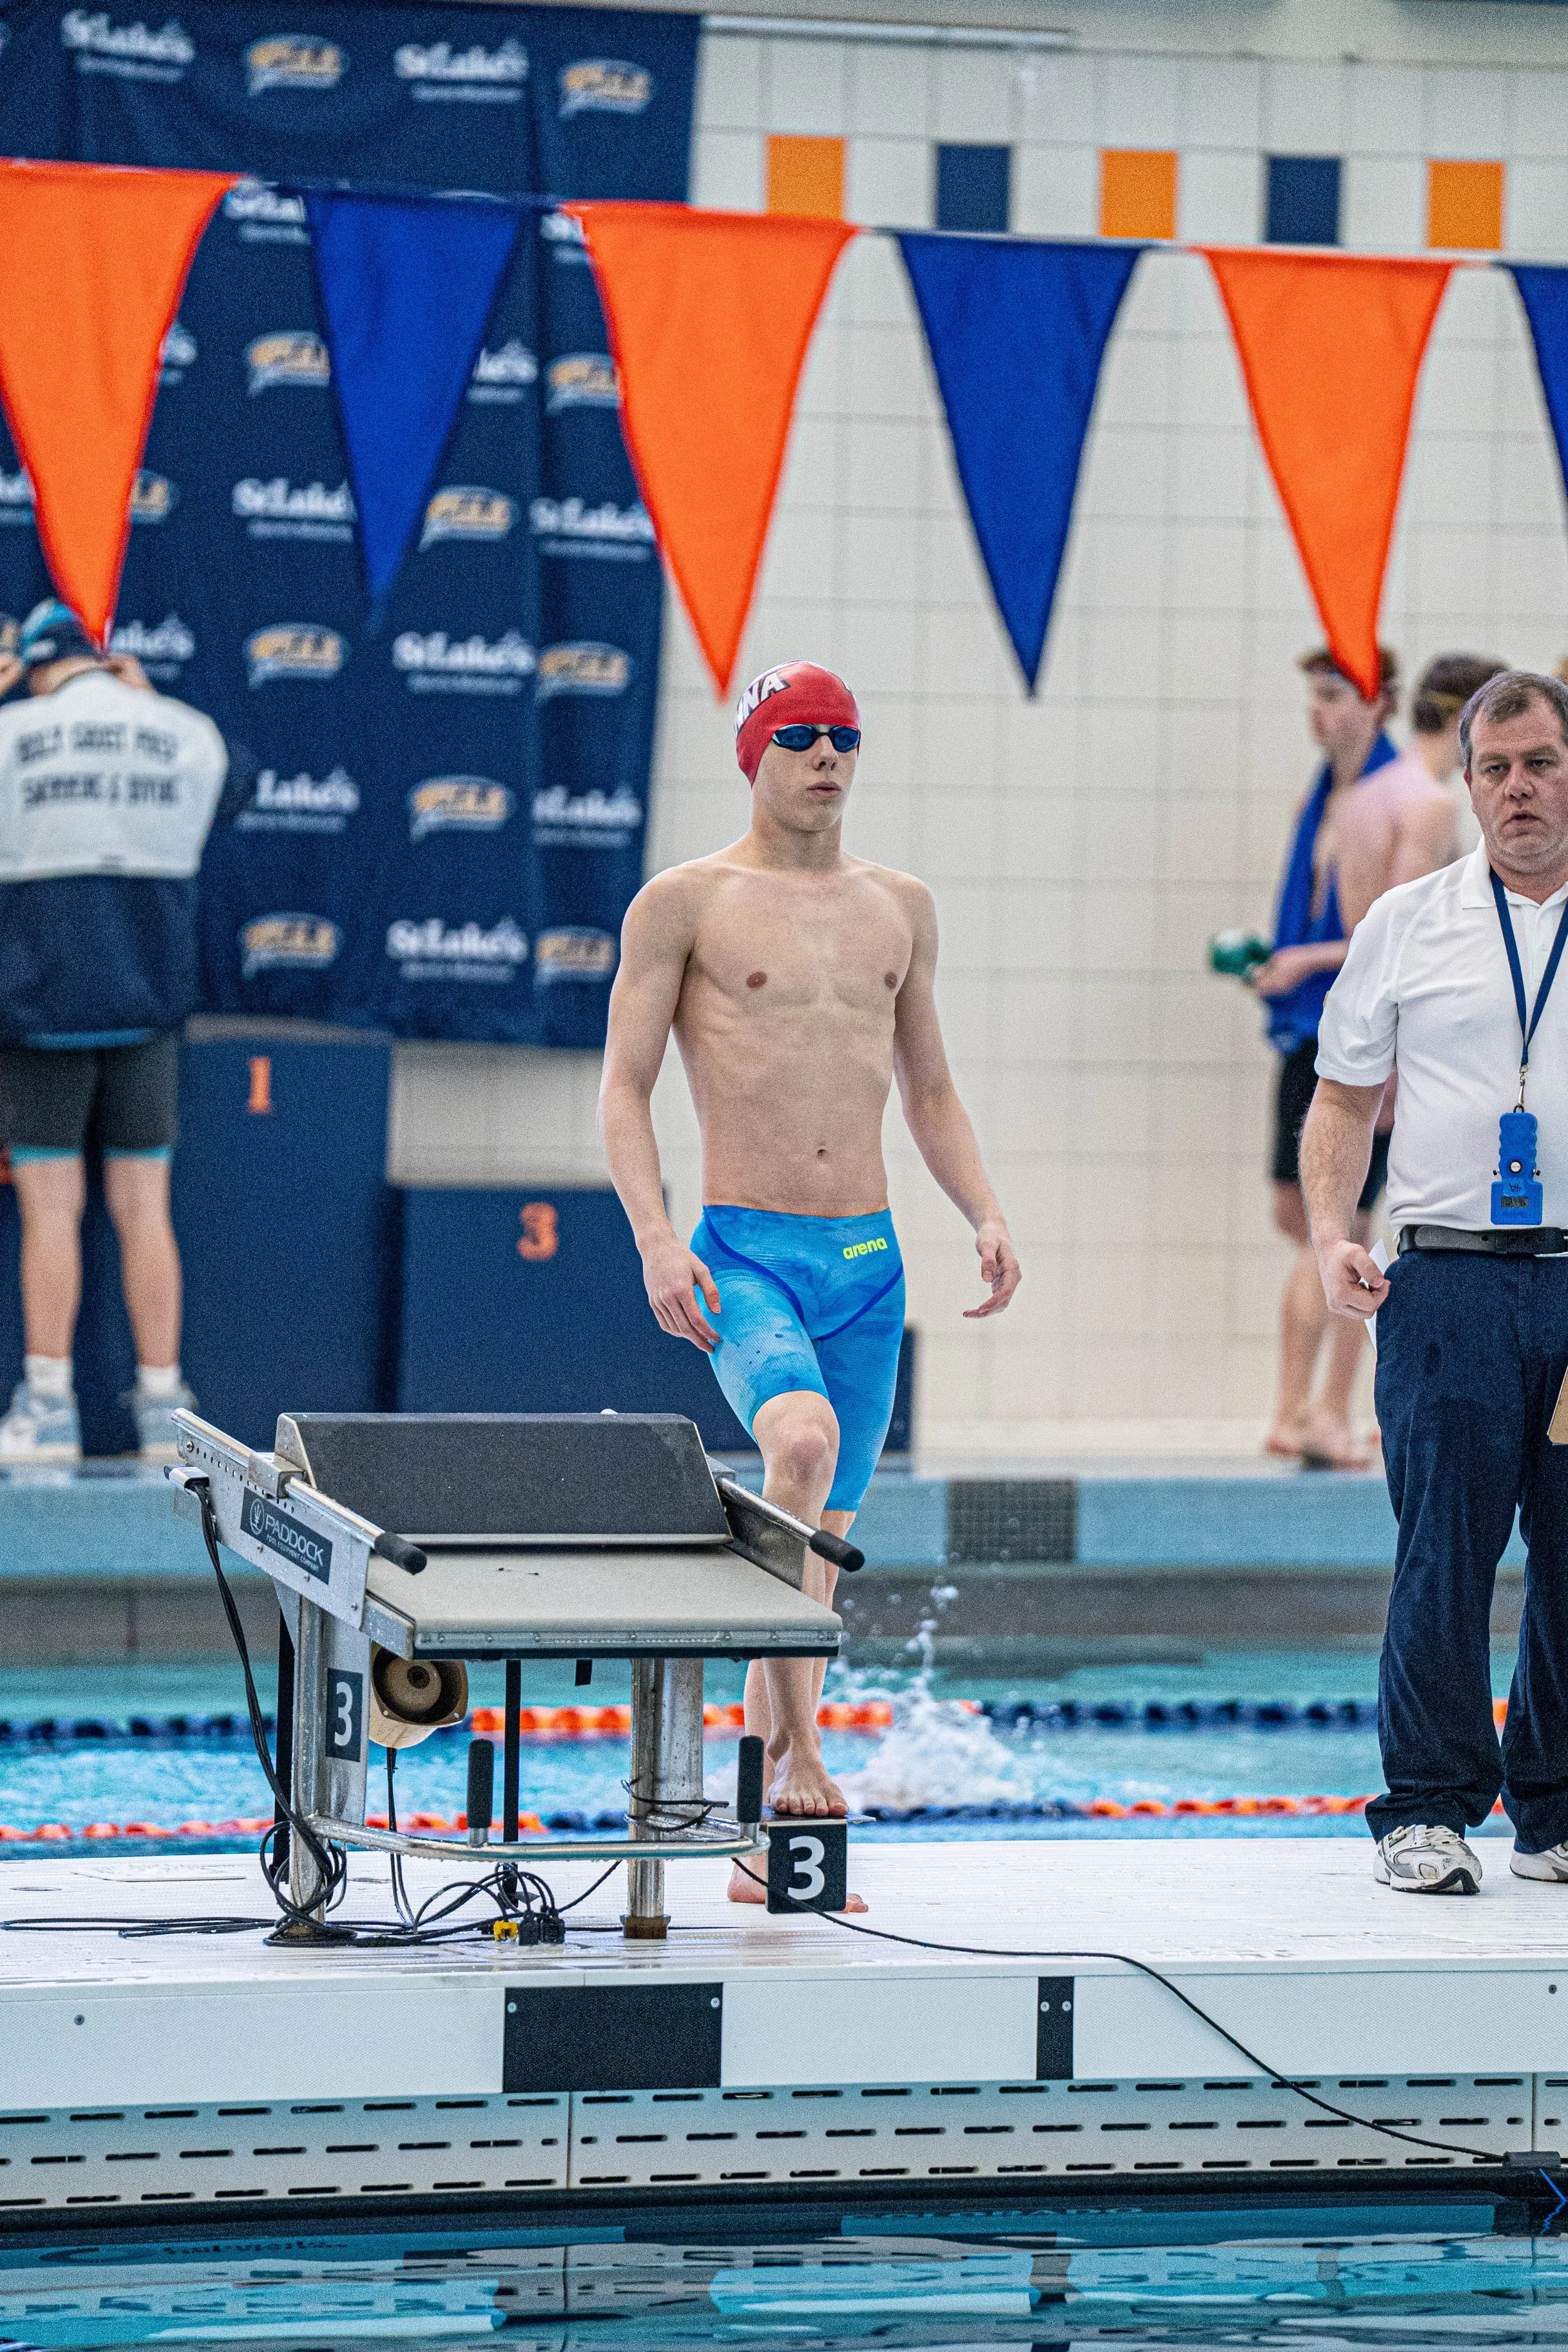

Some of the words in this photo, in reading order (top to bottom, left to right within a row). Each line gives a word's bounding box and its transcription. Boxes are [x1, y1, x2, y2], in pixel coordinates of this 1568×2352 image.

[248, 1056, 272, 1114] 1
[517, 1202, 558, 1260] 3
[843, 1237, 887, 1259] arena
[265, 1513, 324, 1566] PADDOCK
[334, 1682, 353, 1746] 3
[788, 1836, 825, 1900] 3
